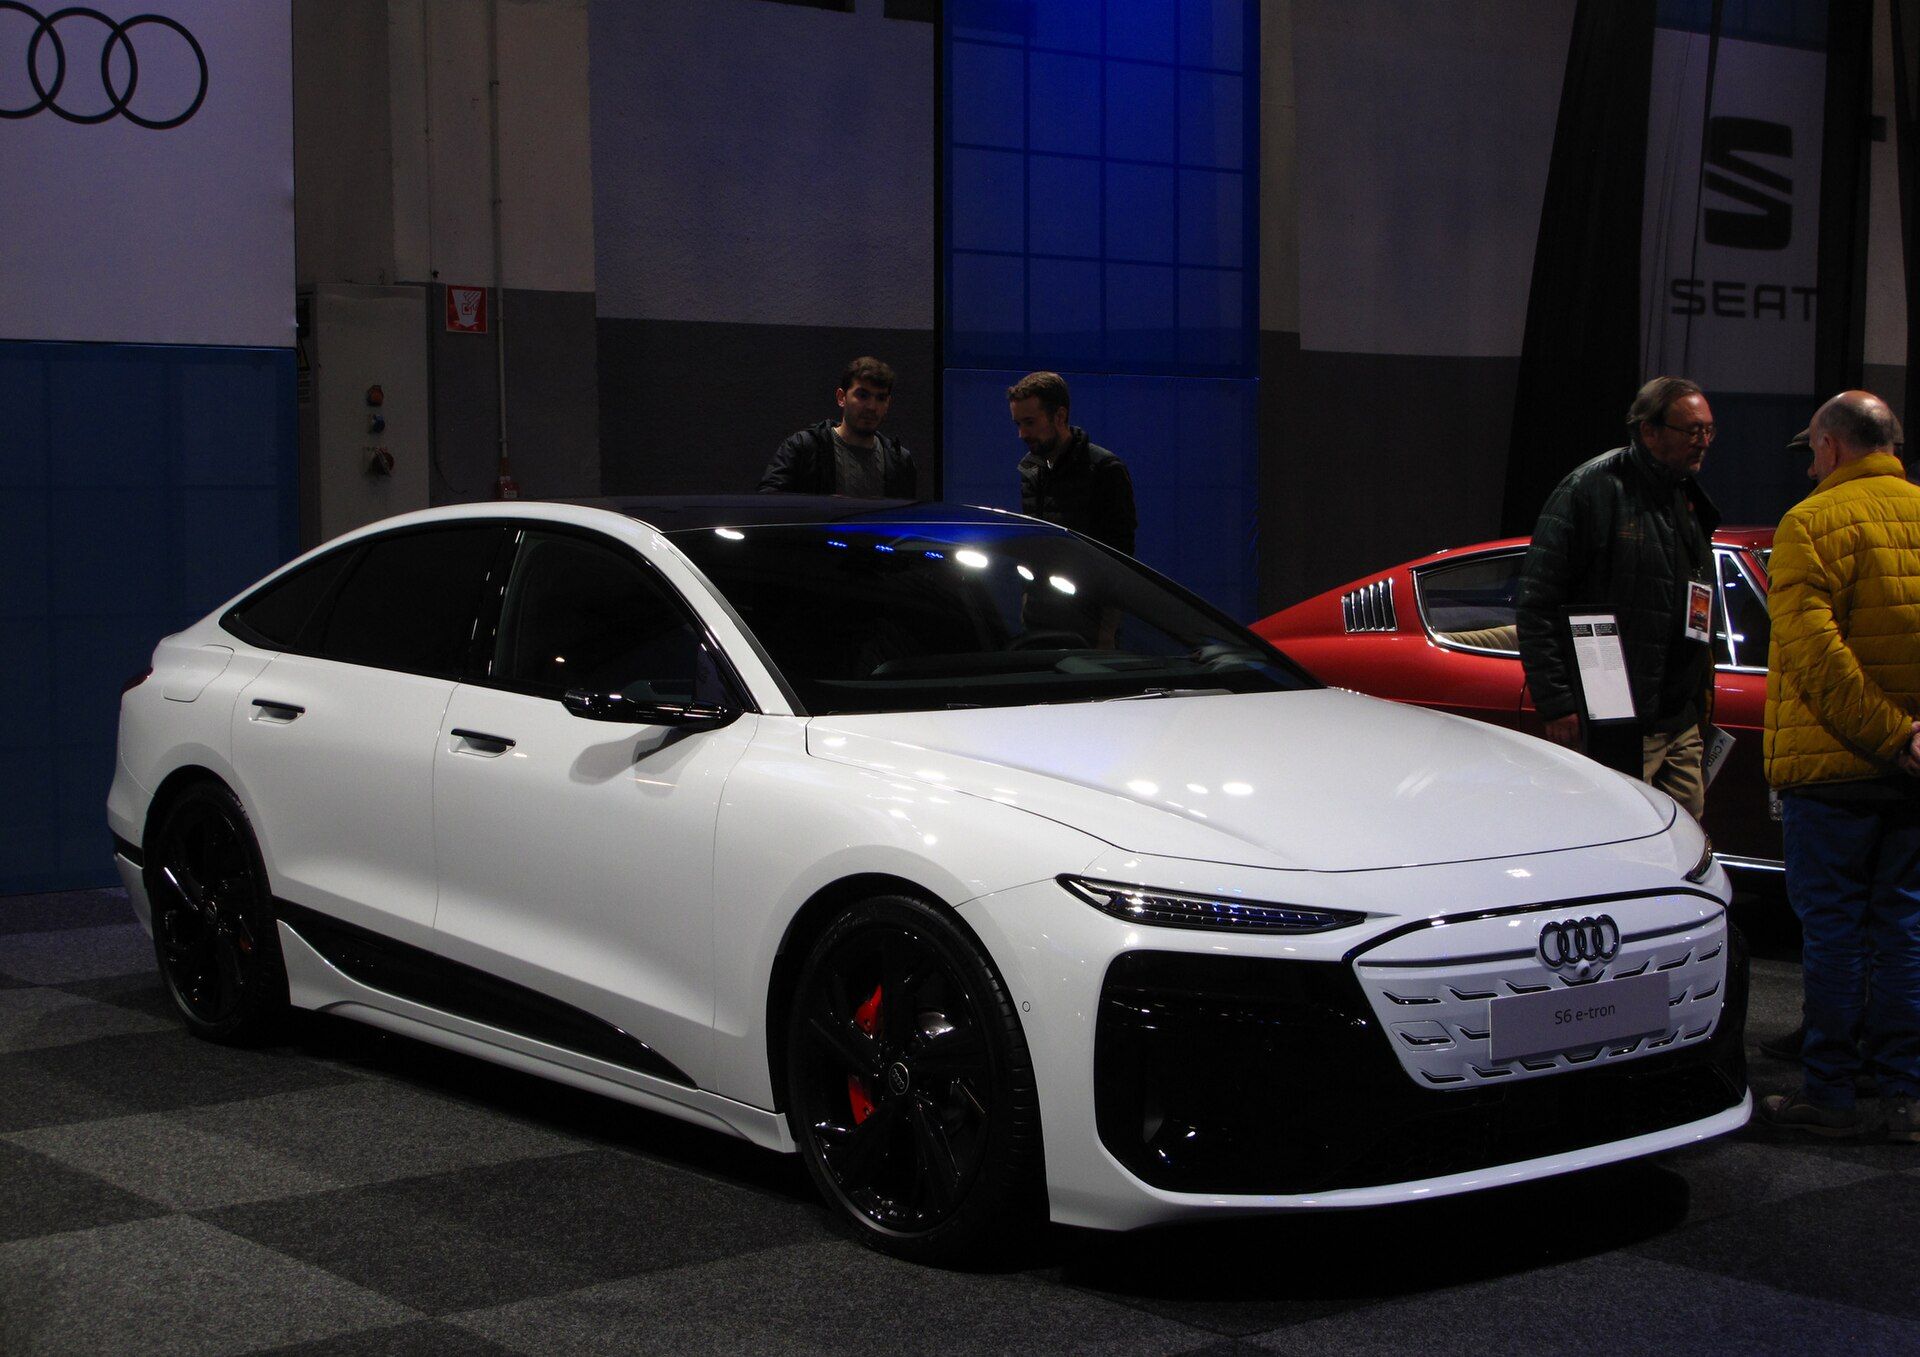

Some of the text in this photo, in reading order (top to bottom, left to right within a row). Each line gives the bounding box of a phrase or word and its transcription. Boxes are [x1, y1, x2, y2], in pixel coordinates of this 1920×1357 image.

[1670, 278, 1819, 321] SEAT
[1555, 1004, 1616, 1025] S6 e-tron
